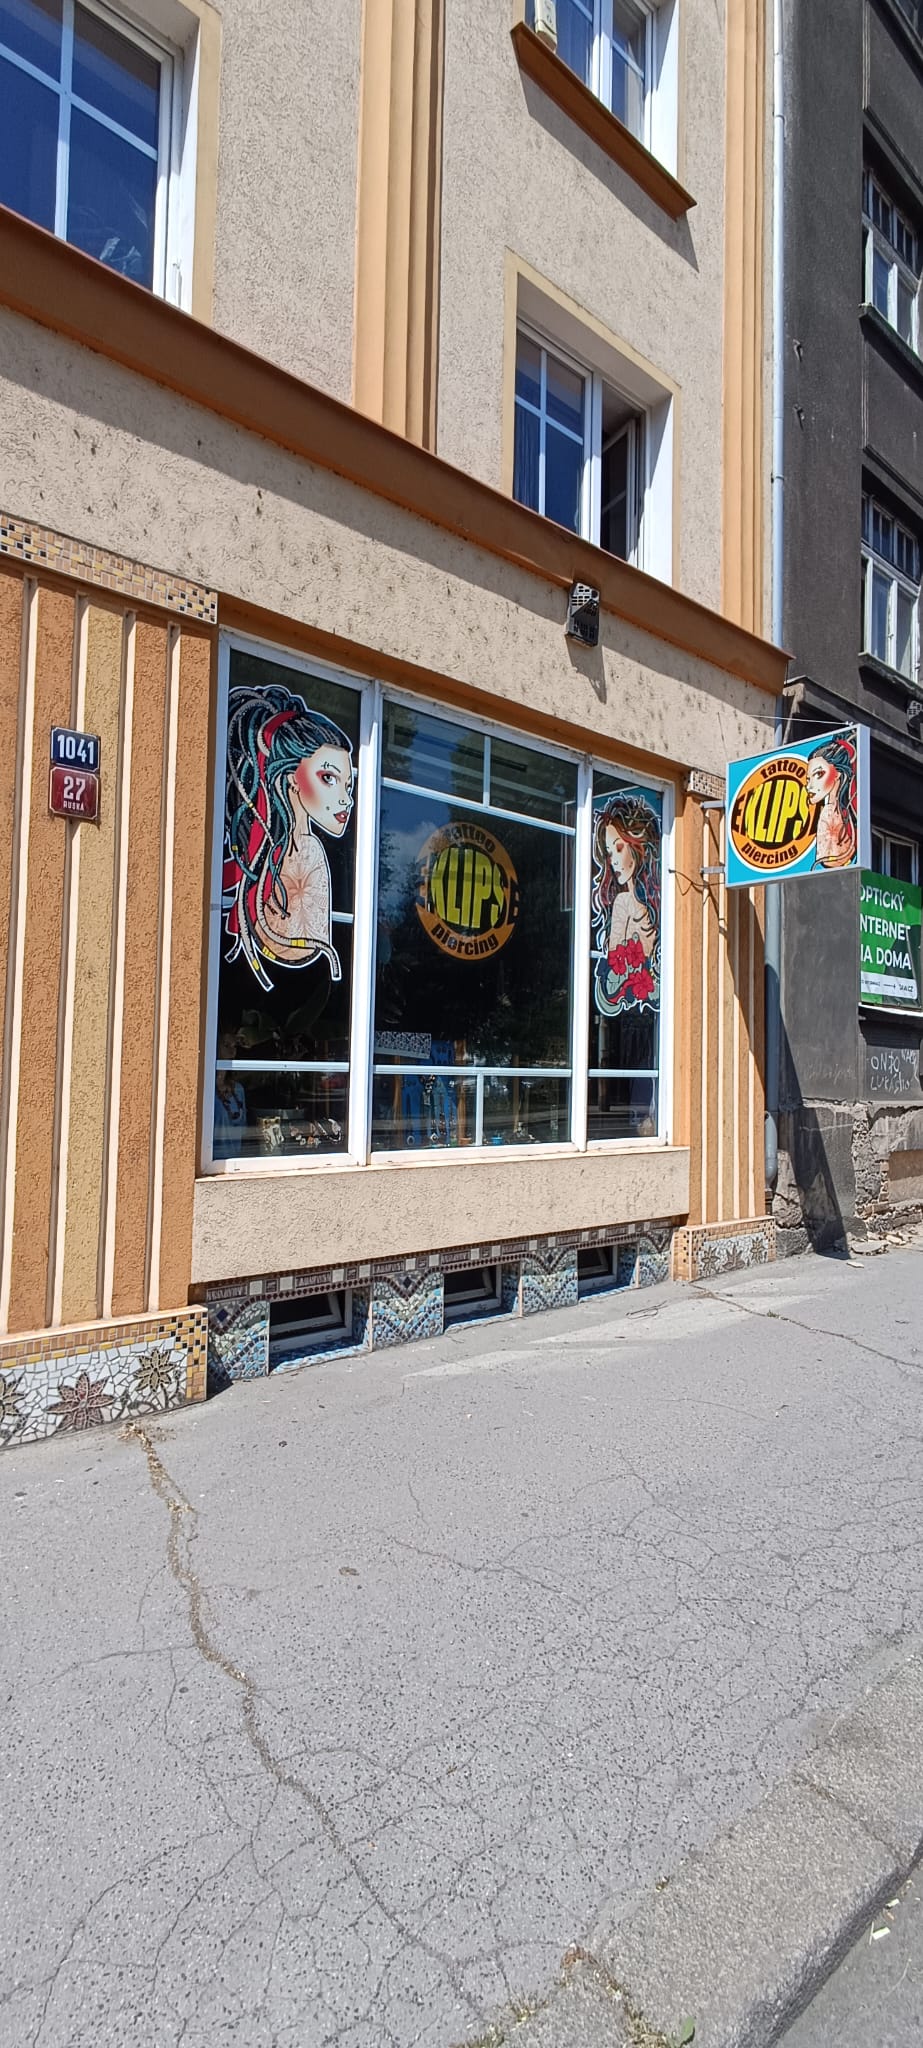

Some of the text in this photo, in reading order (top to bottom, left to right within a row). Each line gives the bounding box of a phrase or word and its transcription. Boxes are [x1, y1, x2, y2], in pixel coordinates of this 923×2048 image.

[57, 734, 94, 765] 1041
[760, 759, 806, 779] tattoo
[63, 775, 86, 801] 27
[741, 843, 799, 865] piercing
[431, 923, 499, 955] piercing
[860, 913, 911, 941] NTERNET
[876, 946, 912, 970] DOMA
